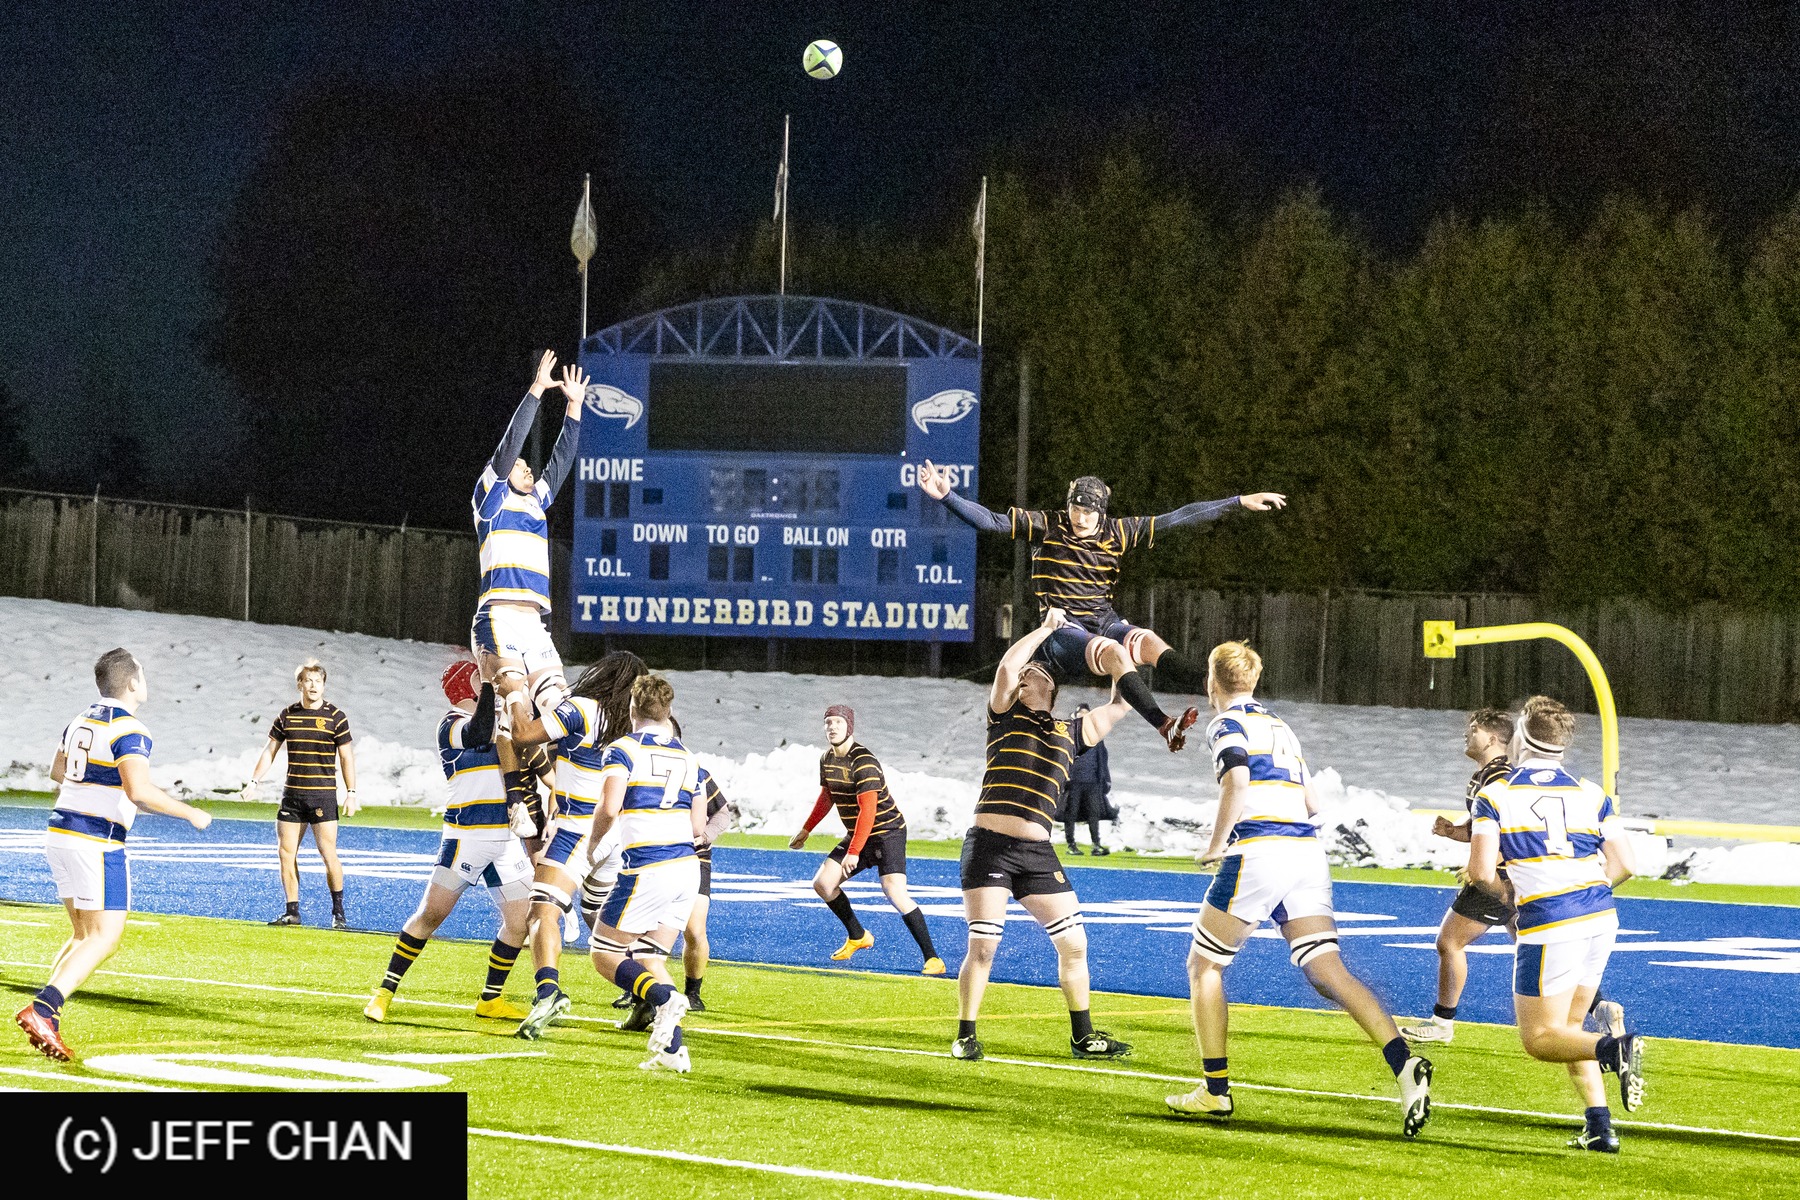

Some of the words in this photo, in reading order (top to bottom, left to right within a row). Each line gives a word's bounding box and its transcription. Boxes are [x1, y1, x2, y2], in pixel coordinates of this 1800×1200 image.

[580, 458, 644, 482] HOME
[632, 523, 689, 543] DOWN
[705, 525, 730, 544] TO
[734, 525, 760, 544] GO
[782, 527, 823, 546] BALL
[826, 527, 850, 547] ON
[871, 528, 908, 548] QTR
[585, 557, 632, 577] T.O.L.
[915, 564, 963, 584] T.O.L.
[577, 595, 814, 628] THUNDERBIRD
[822, 601, 970, 630] STADIUM
[64, 726, 94, 784] 6
[650, 752, 688, 811] 7
[1529, 795, 1575, 859] 1
